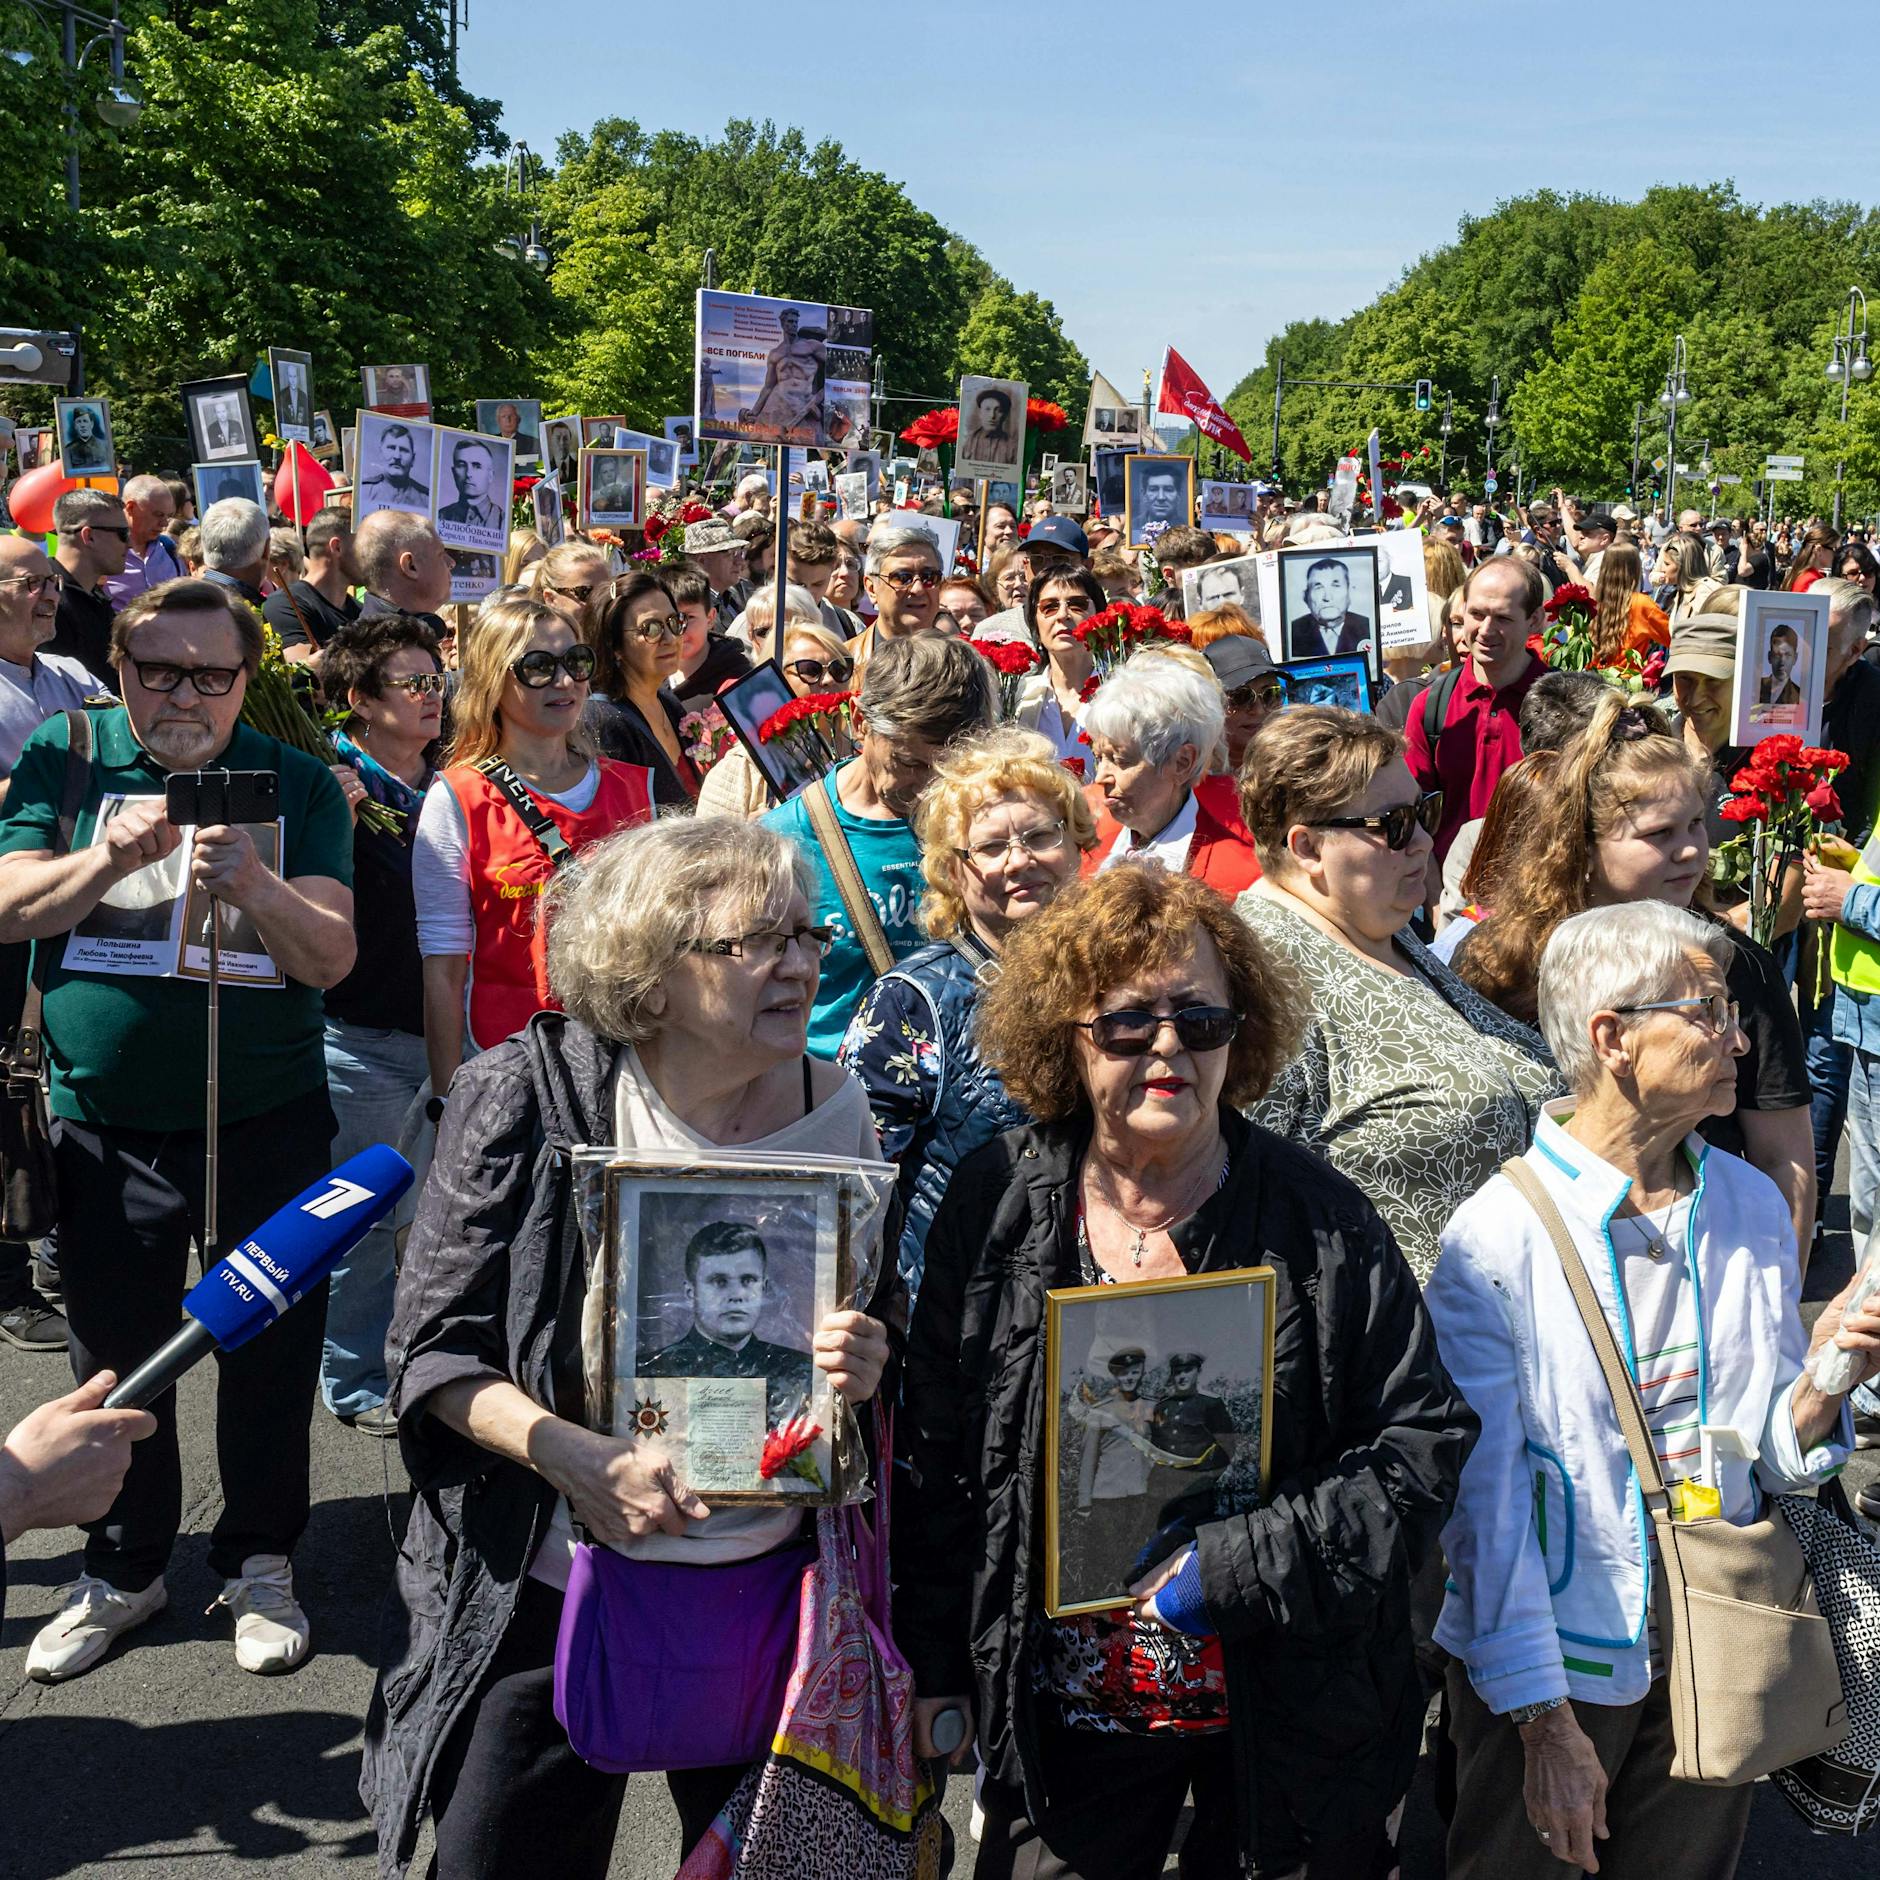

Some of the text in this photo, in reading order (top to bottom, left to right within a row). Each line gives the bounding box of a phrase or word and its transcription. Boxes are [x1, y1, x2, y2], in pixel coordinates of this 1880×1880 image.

[707, 347, 765, 360] ВСЕ ПОГИБЛИ
[440, 520, 504, 540] Залюбовский
[469, 535, 503, 548] Павлович
[96, 938, 141, 949] Польшина
[77, 949, 154, 961] Любовь Тимофеевна
[243, 1240, 290, 1283] ПЕРВЫЙ
[219, 1268, 255, 1303] 1TV.RU
